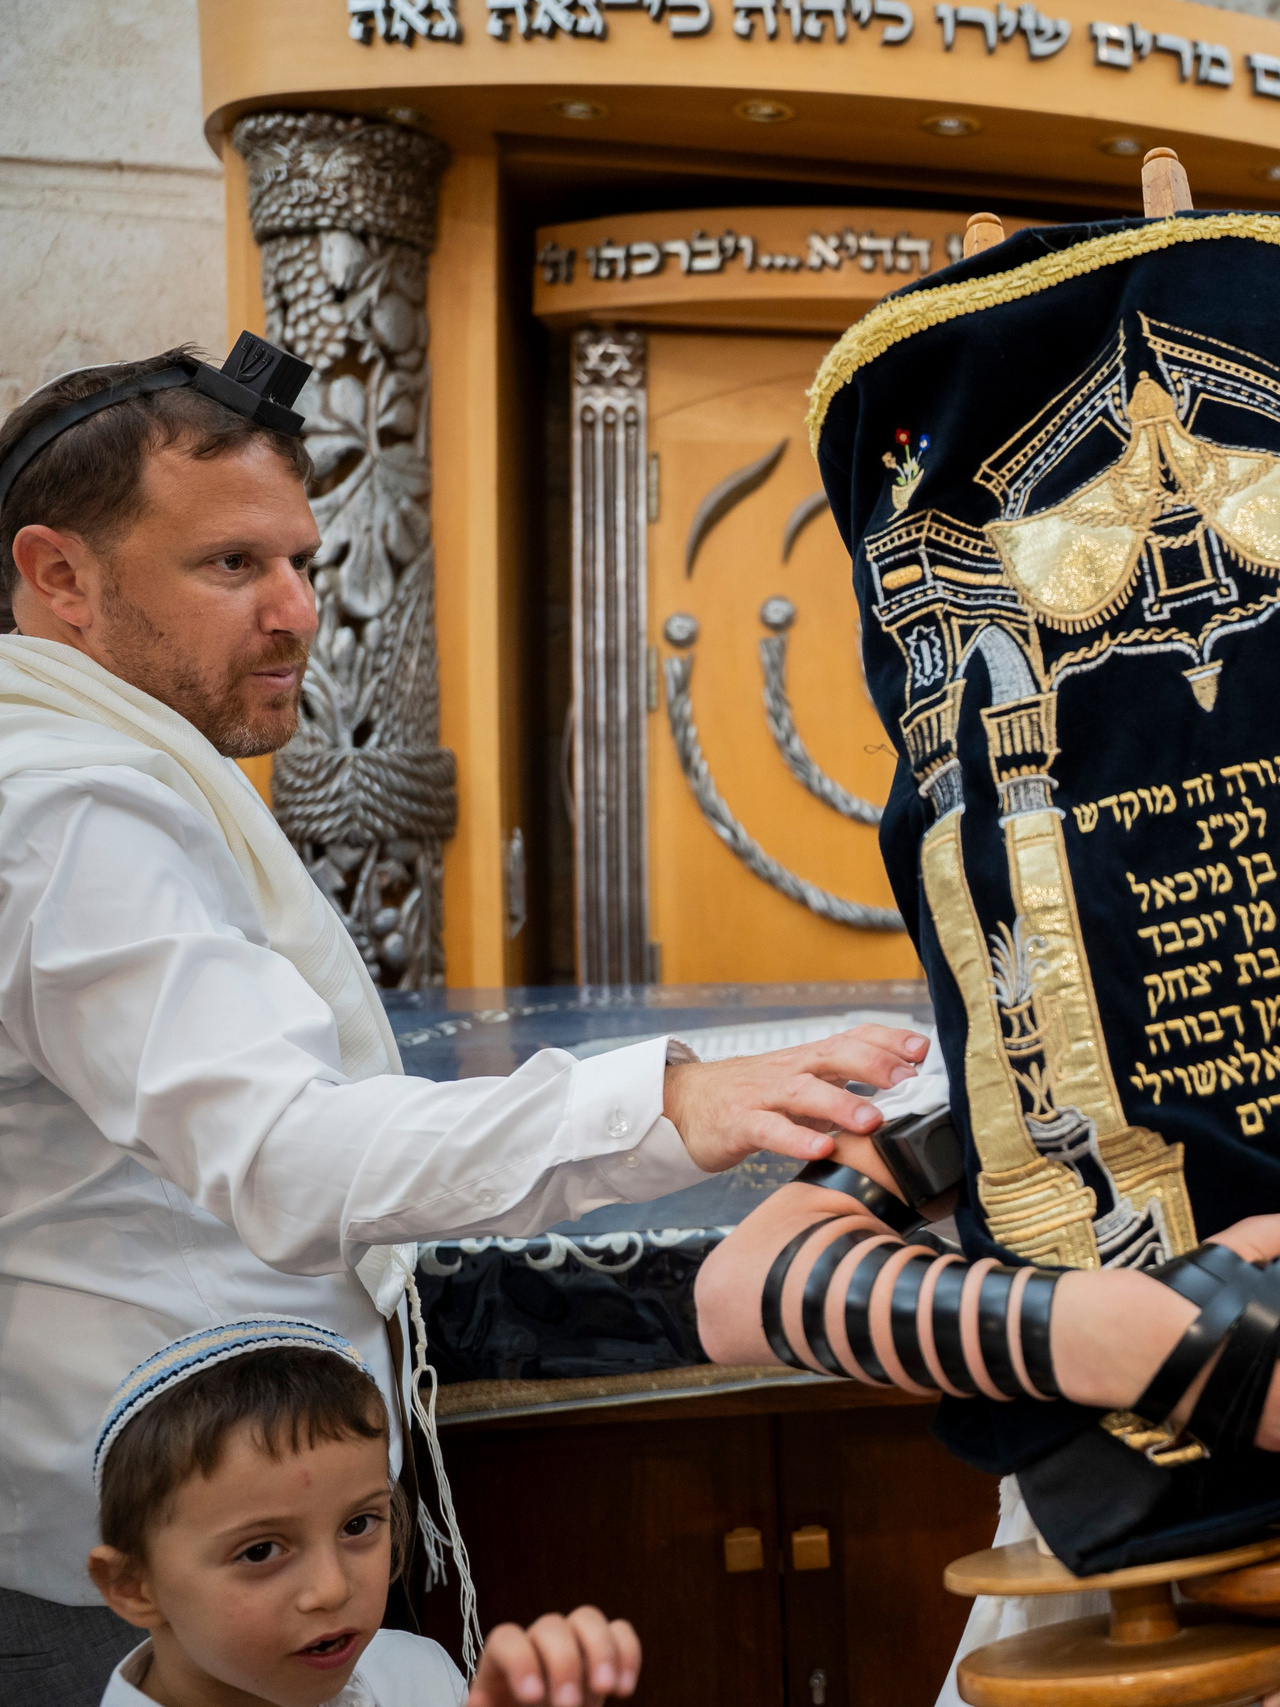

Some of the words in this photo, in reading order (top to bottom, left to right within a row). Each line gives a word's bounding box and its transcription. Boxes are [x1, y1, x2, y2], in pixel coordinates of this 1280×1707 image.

[347, 0, 458, 42] גאה
[935, 3, 1071, 60] שירו
[1090, 22, 1234, 87] מרים
[1072, 785, 1177, 833] מוקדש
[1182, 774, 1215, 807] זה
[1126, 862, 1233, 913] מיכאל
[1237, 852, 1277, 897] בן
[1137, 911, 1227, 957] יוכבד
[1233, 900, 1276, 947] מן
[1143, 960, 1222, 1018] יצחק
[1145, 1005, 1245, 1055] דבורה
